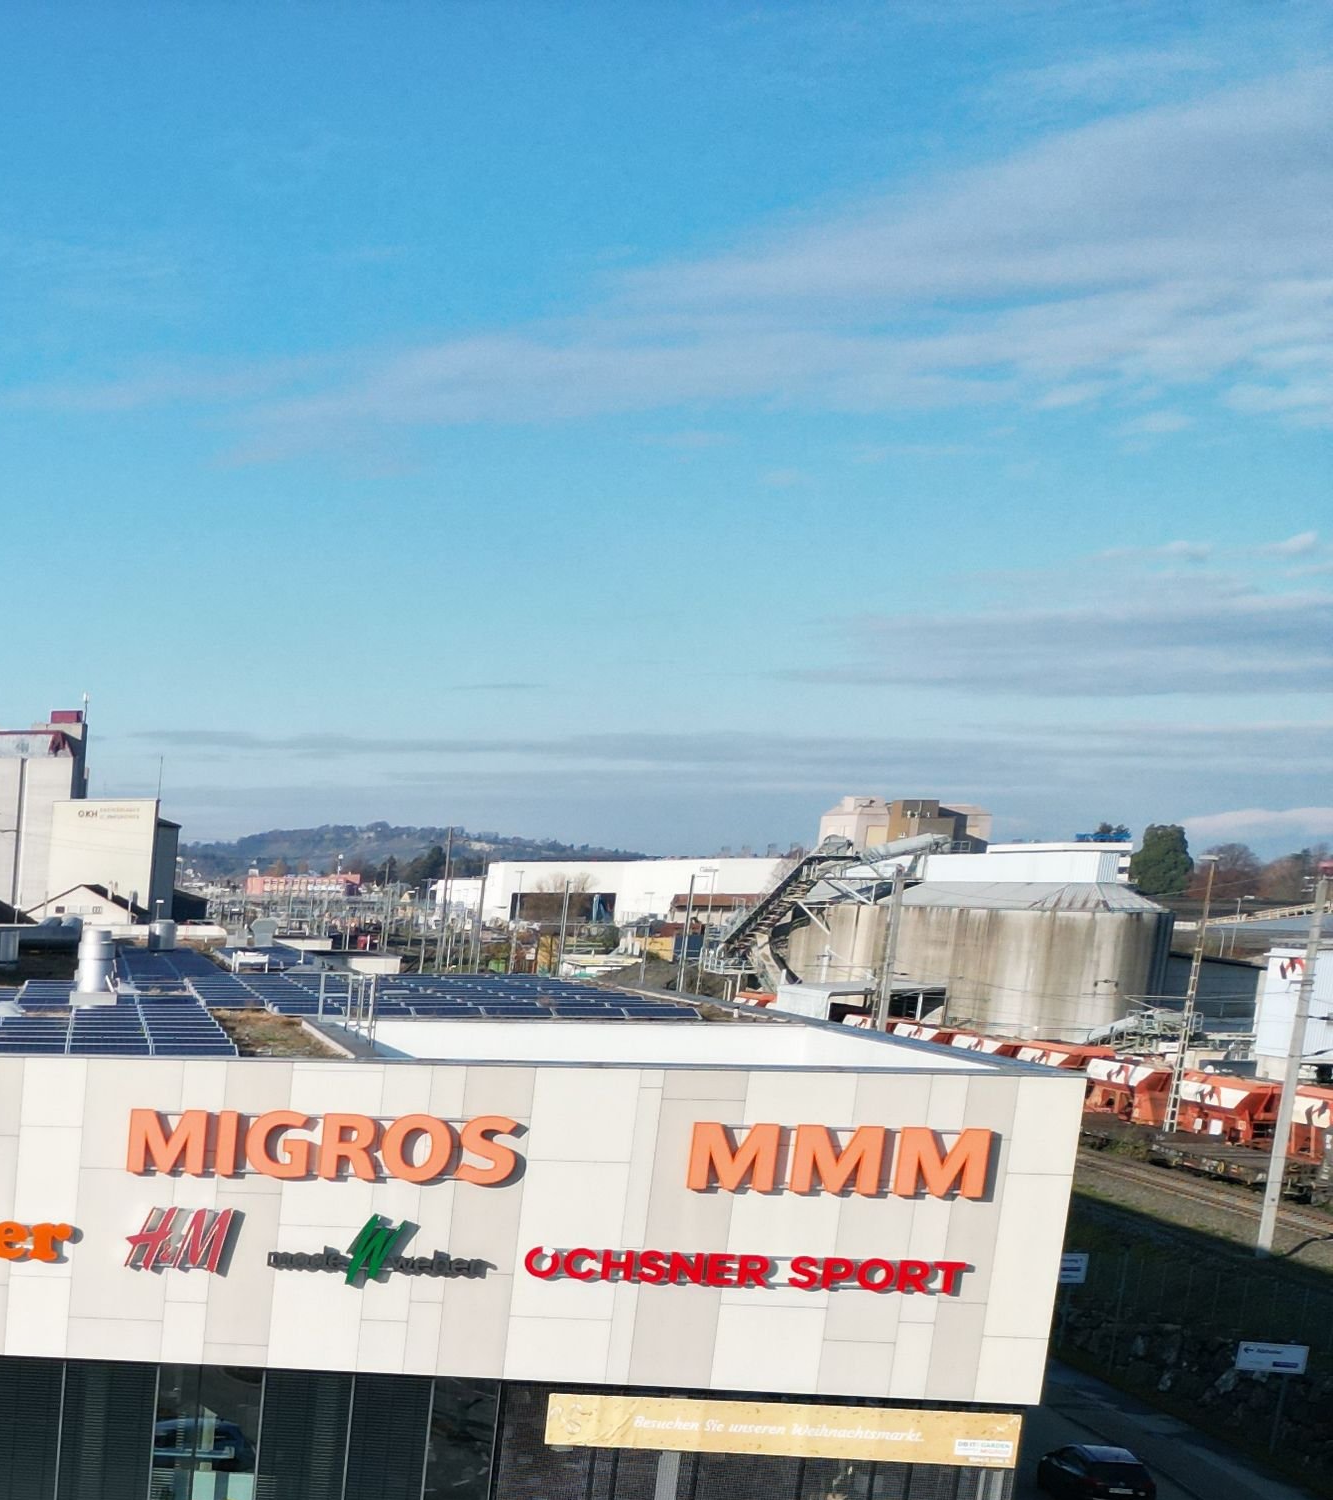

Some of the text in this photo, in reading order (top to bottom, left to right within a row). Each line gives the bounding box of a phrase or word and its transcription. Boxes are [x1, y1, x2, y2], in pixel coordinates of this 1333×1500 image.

[126, 1109, 525, 1185] MIGROS
[687, 1121, 998, 1199] MMM
[125, 1206, 234, 1274] H&M
[524, 1246, 968, 1296] OCHSNER SPORT
[633, 1415, 700, 1432] Besuchen
[704, 1419, 723, 1433] Sie
[729, 1423, 786, 1436] unseren
